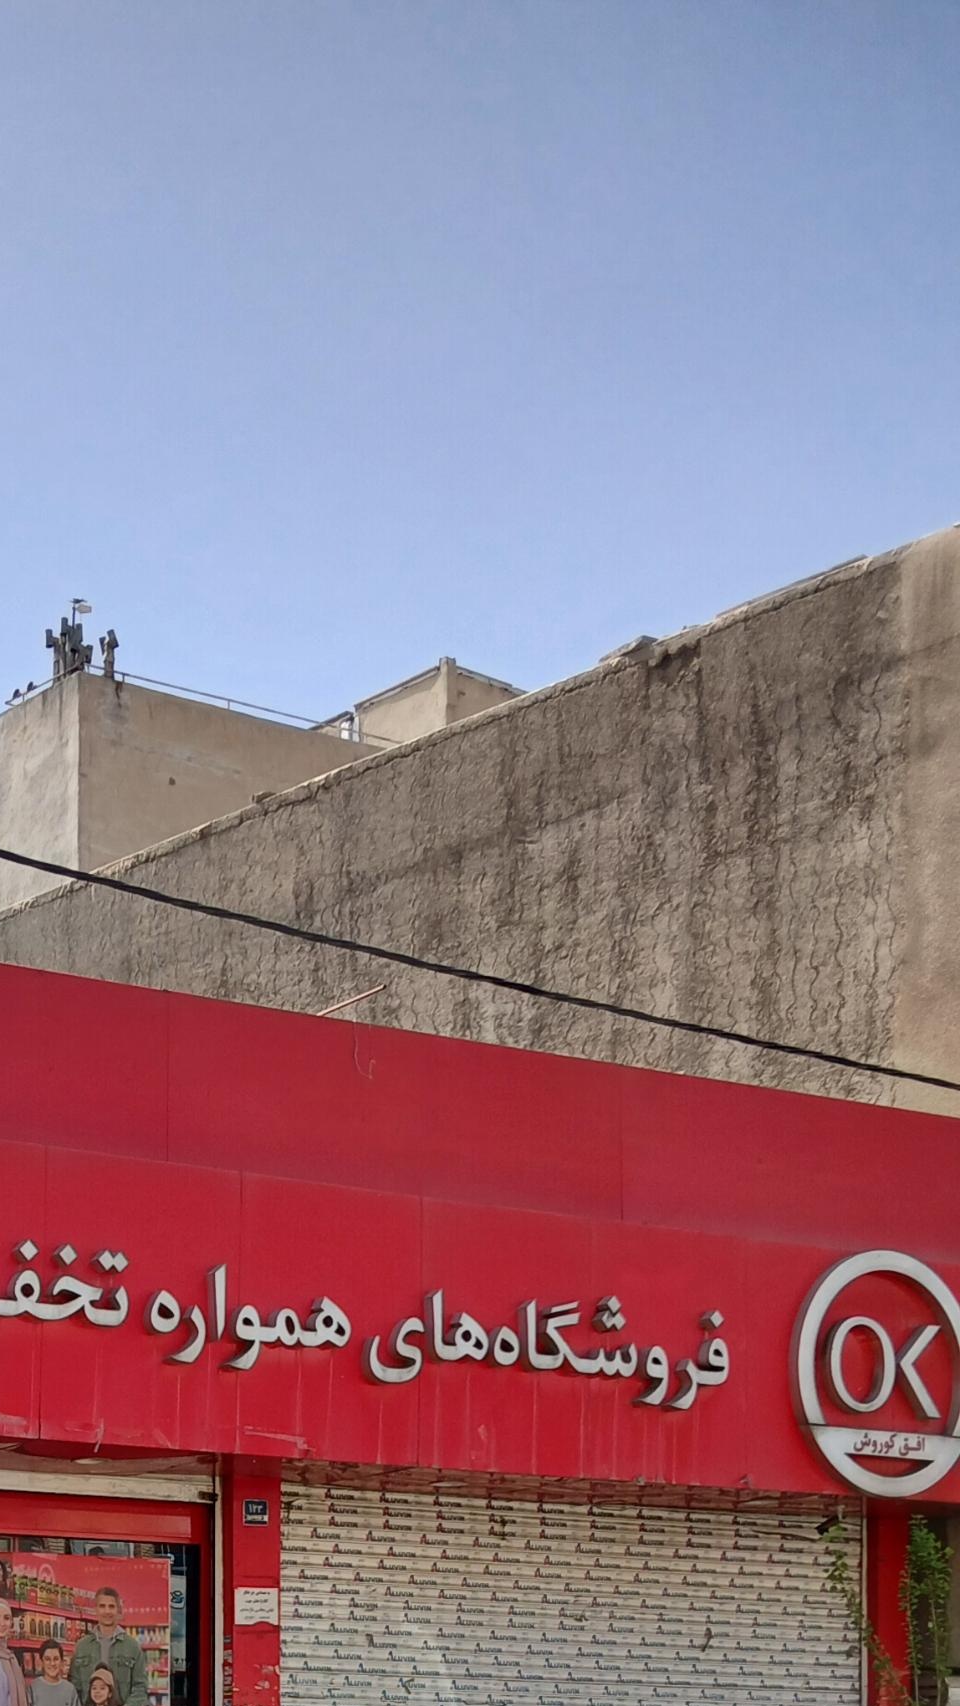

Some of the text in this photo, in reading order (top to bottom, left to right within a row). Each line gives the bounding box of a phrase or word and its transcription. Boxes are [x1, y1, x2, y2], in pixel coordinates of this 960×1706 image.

[146, 1264, 352, 1371] همواره
[827, 1316, 942, 1420] OK
[853, 1432, 926, 1455] افق کوروش
